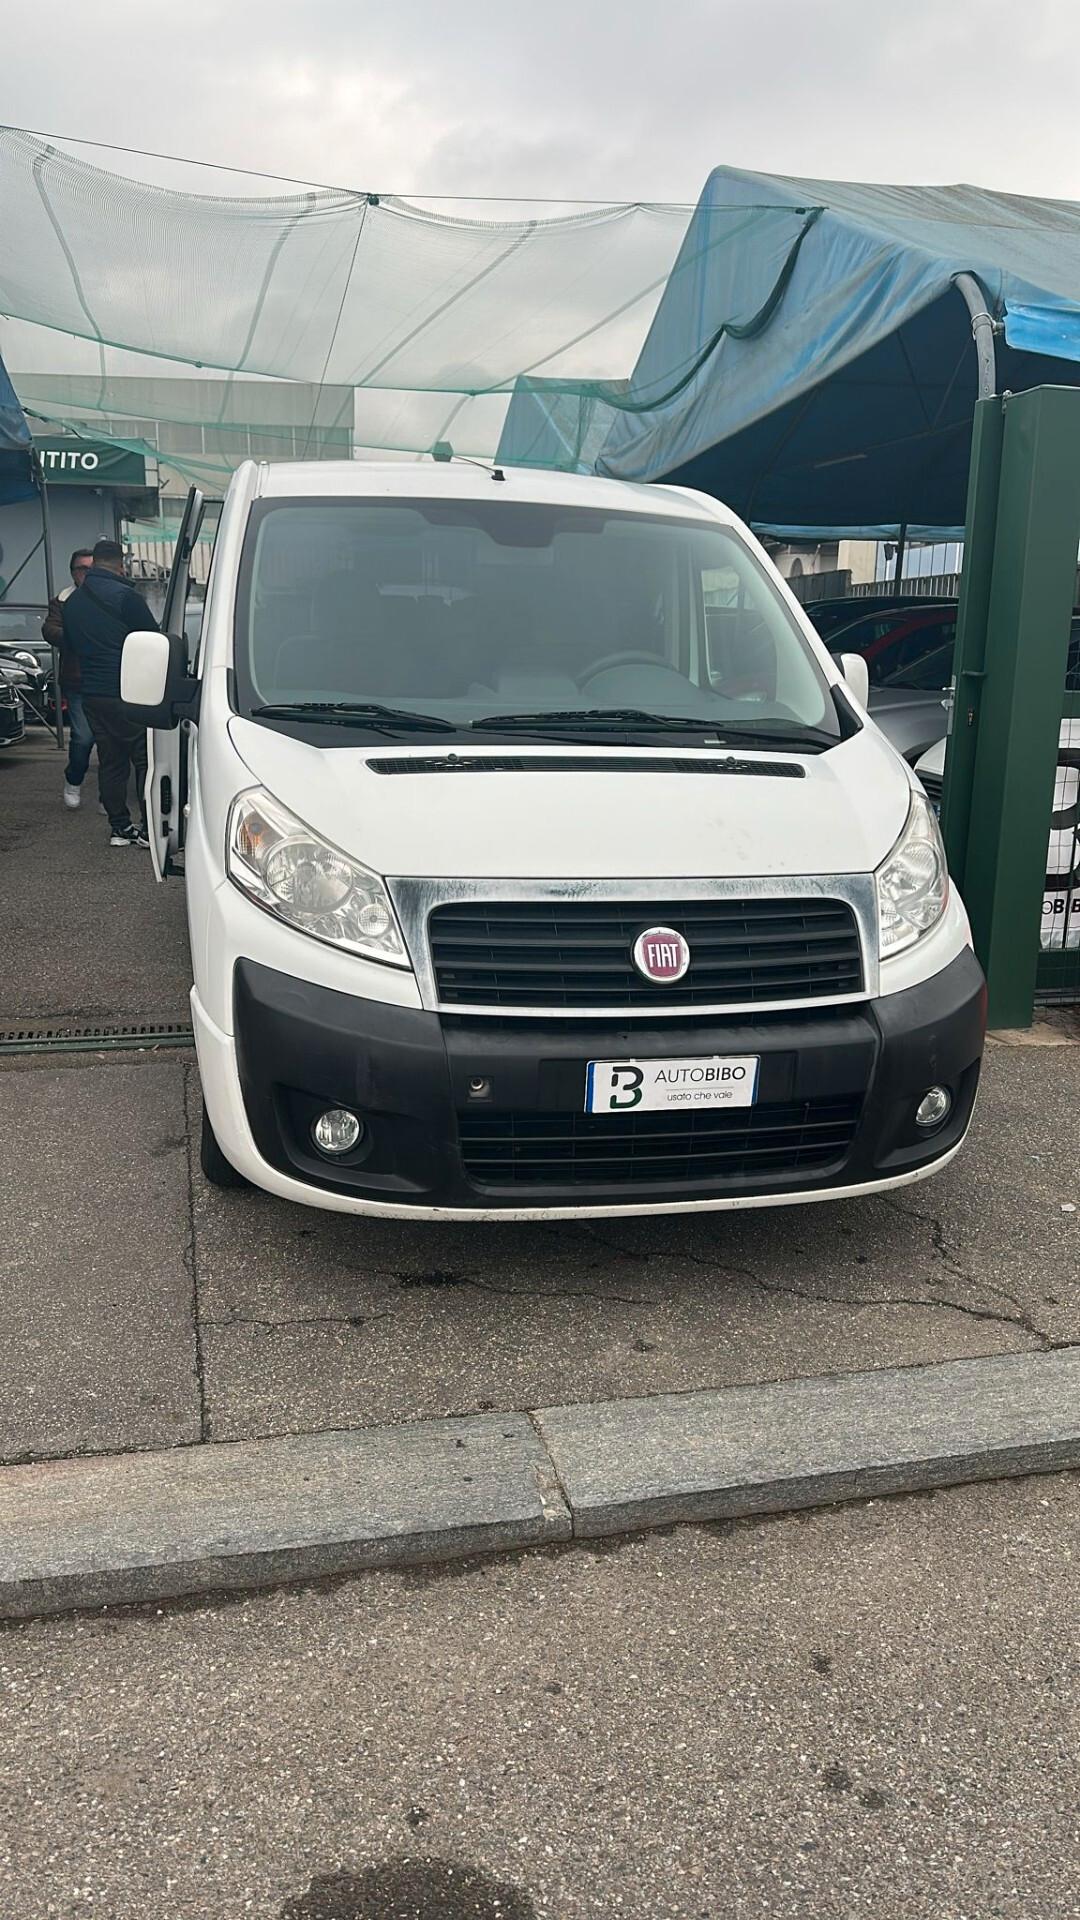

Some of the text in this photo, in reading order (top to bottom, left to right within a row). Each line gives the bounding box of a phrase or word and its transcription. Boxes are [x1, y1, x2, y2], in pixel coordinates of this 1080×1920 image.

[1041, 898, 1080, 915] OBB
[647, 943, 678, 968] FIAT
[654, 1066, 746, 1083] AUTOBIBO
[667, 1090, 733, 1101] usato che vale
